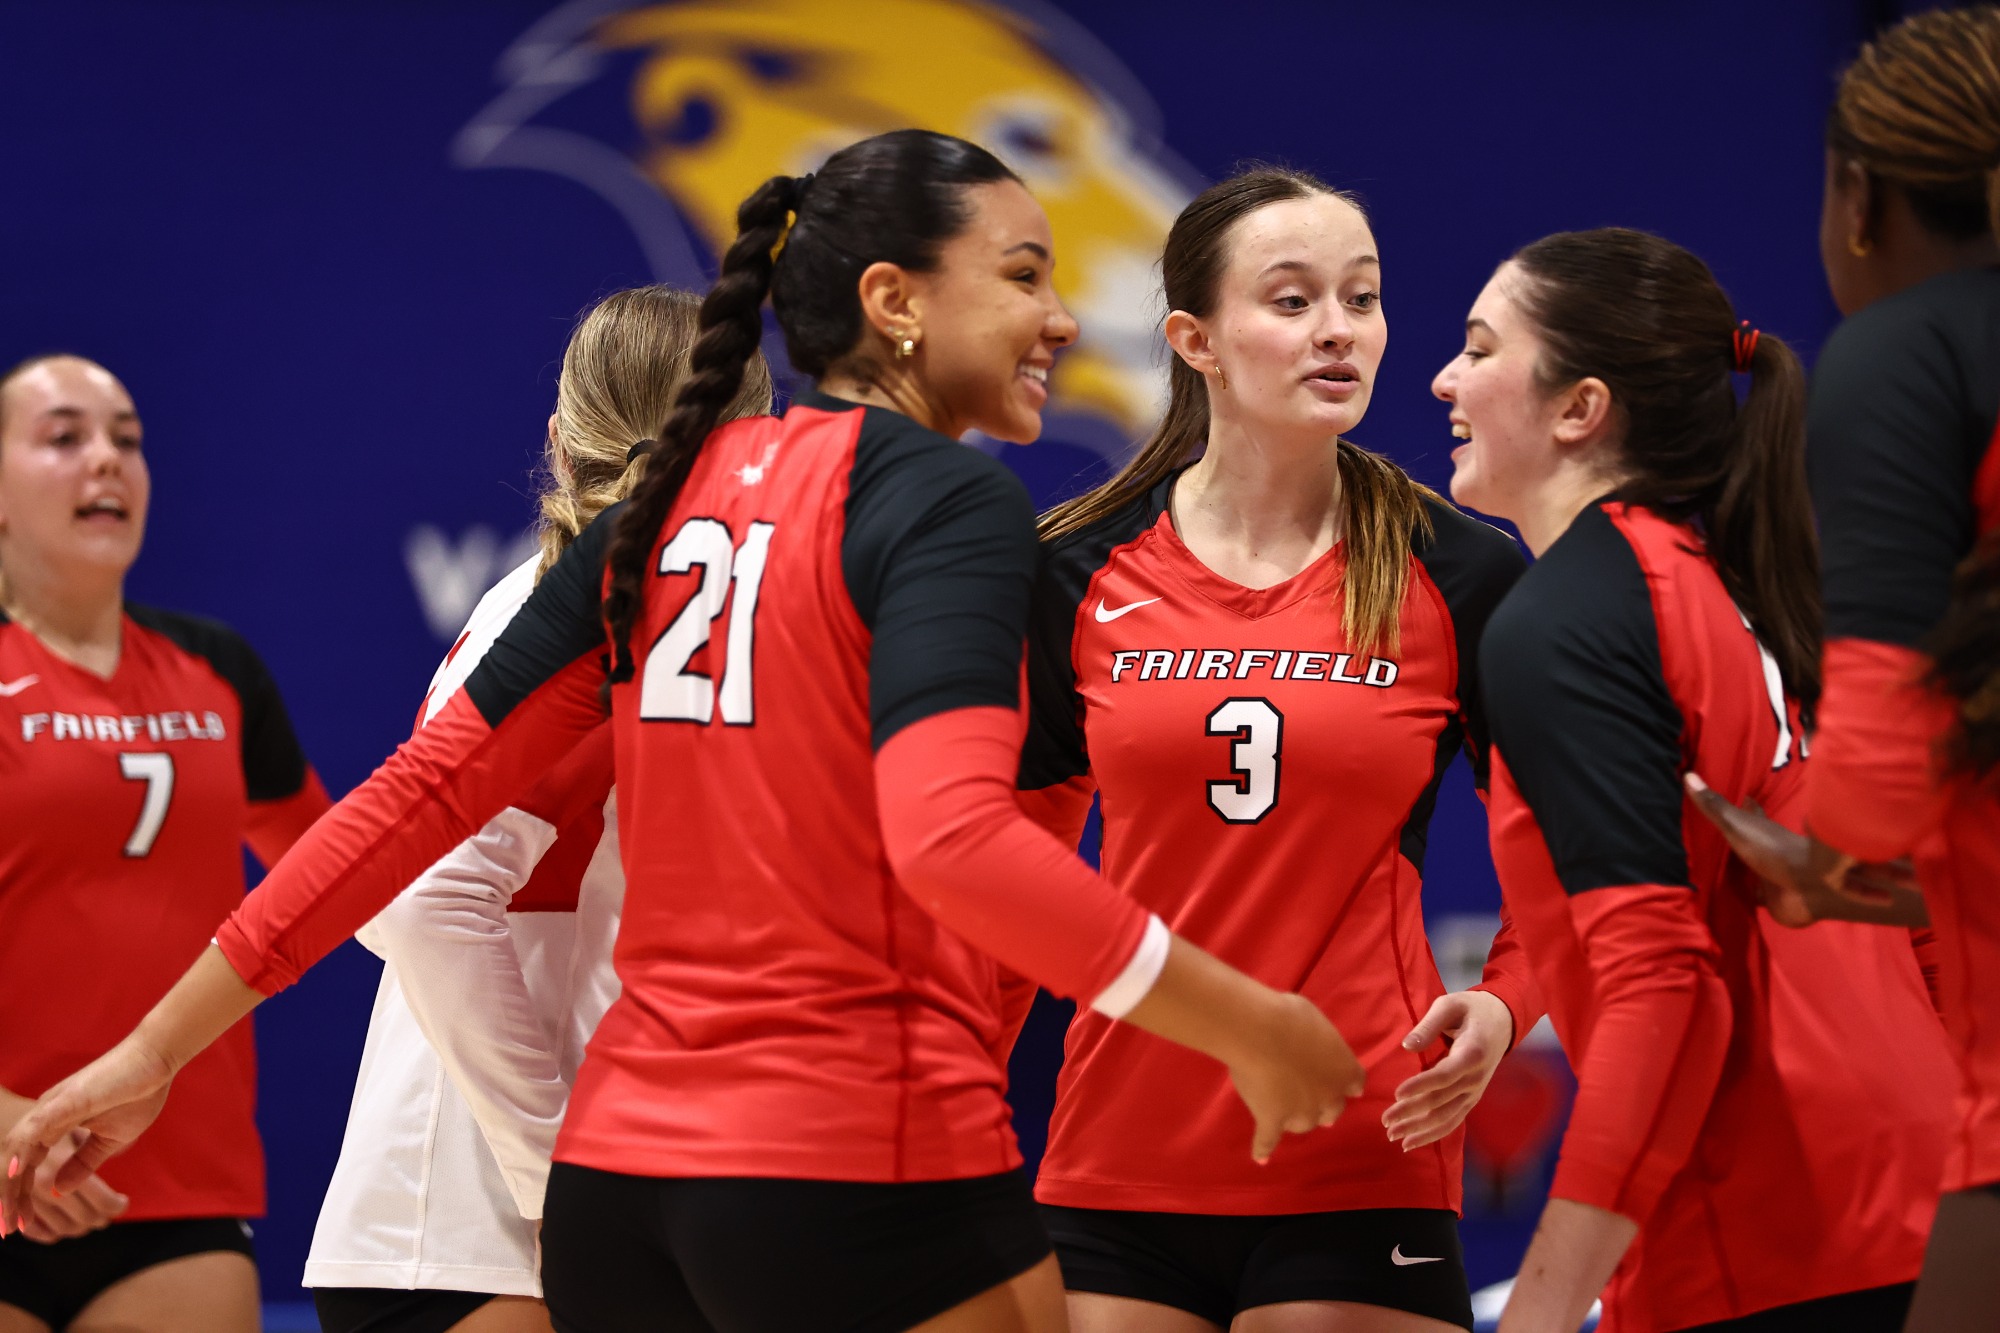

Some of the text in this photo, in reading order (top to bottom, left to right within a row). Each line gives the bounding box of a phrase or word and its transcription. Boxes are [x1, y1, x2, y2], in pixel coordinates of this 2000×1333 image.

[640, 516, 776, 727] 21
[1110, 648, 1399, 689] FAIRFIELD
[20, 711, 227, 742] FAIRFIELD
[1204, 696, 1284, 825] 3
[118, 751, 175, 858] 7
